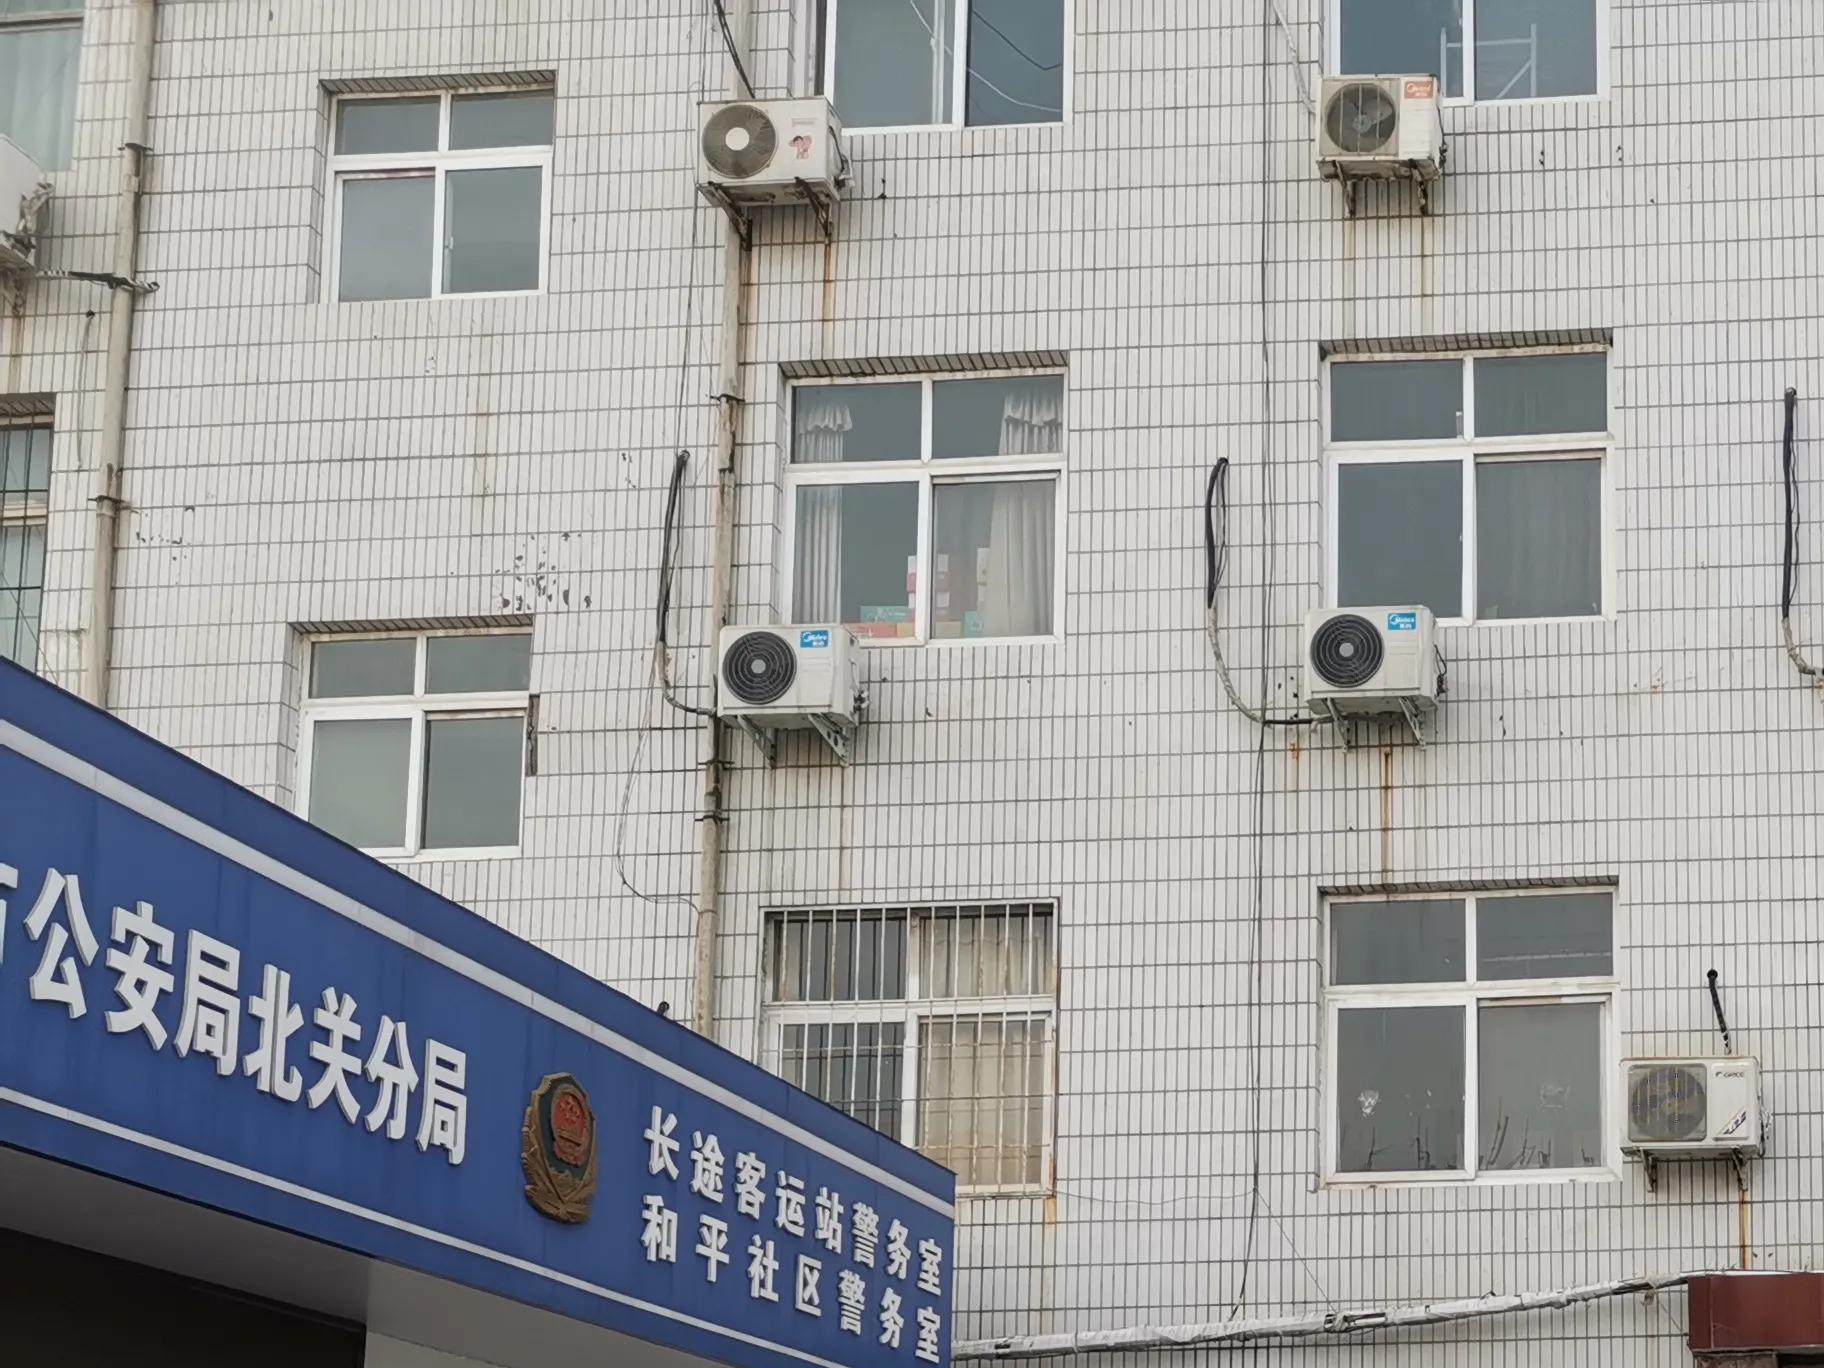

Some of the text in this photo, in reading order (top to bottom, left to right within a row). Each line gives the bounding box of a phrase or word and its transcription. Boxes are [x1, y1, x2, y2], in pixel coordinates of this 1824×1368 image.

[641, 1195, 941, 1364] 和平社区警务室
[643, 1105, 942, 1296] 长途客运站警务室
